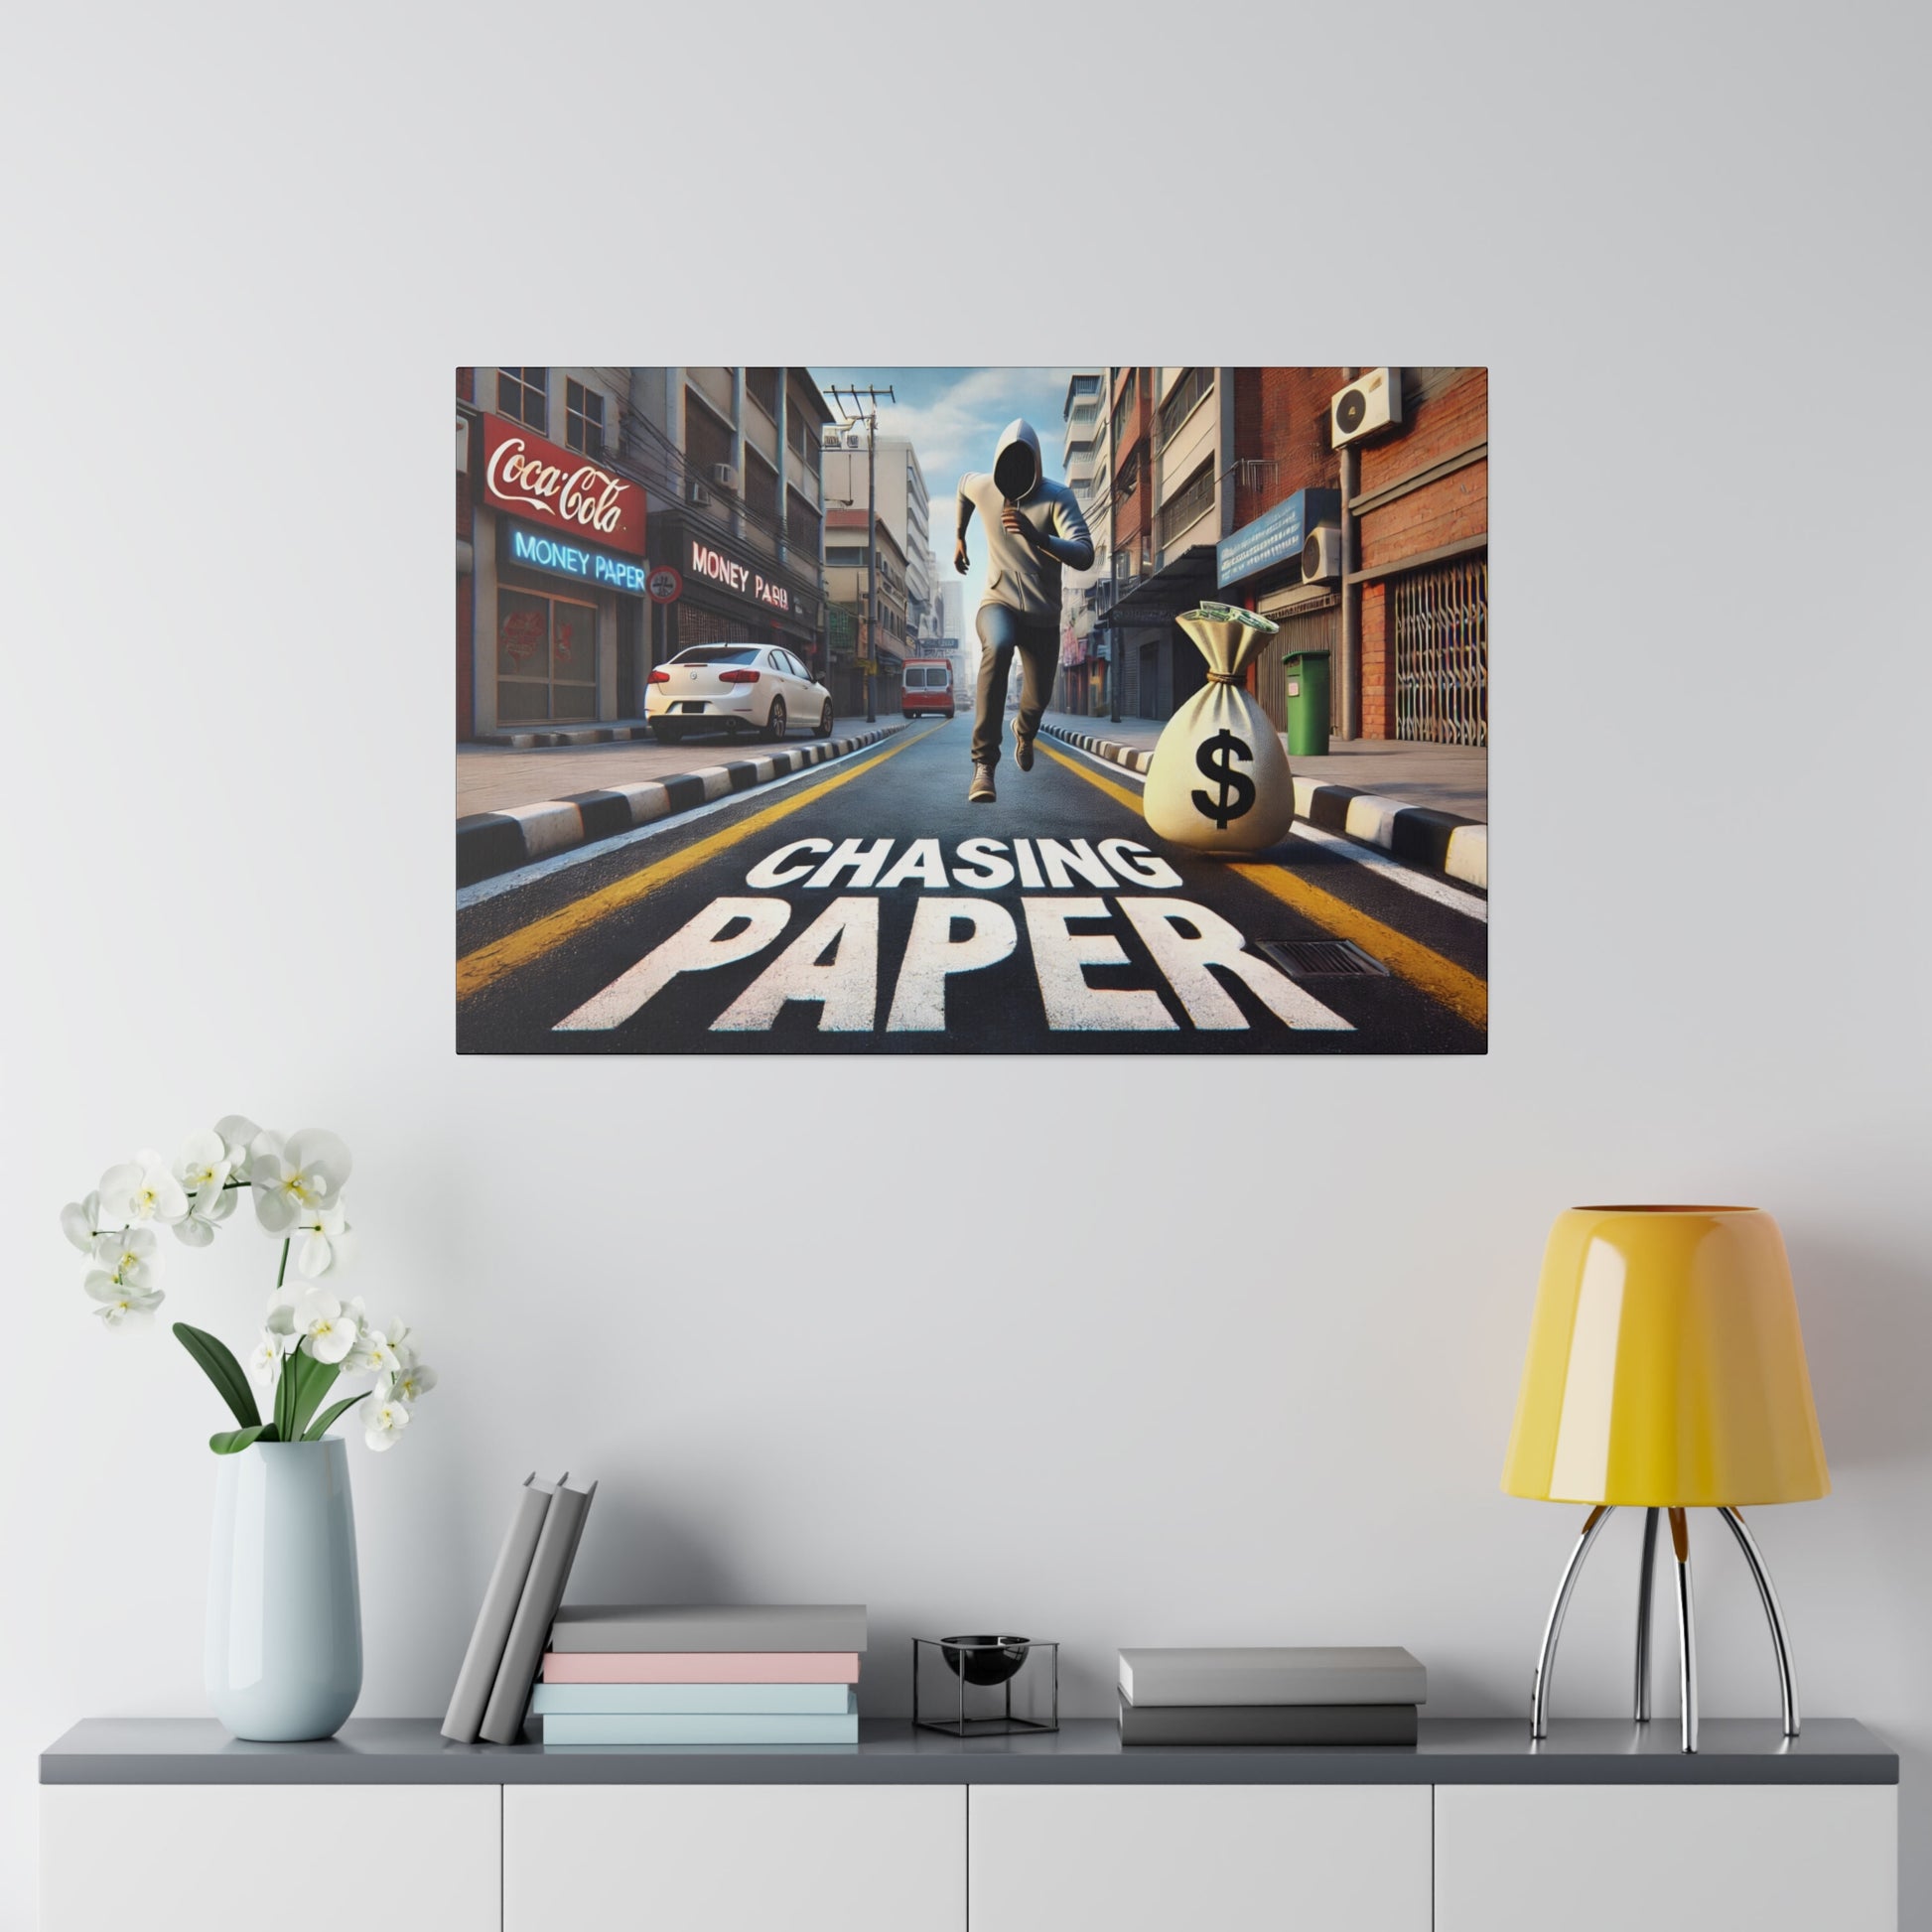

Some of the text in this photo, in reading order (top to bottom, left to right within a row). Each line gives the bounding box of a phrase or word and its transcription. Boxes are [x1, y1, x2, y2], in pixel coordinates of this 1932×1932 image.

[514, 531, 645, 592] MONEY PAPER
[692, 540, 750, 593] MONEY
[1191, 729, 1256, 830] $
[747, 838, 1183, 889] CHASING
[552, 897, 1357, 1032] PAPER
